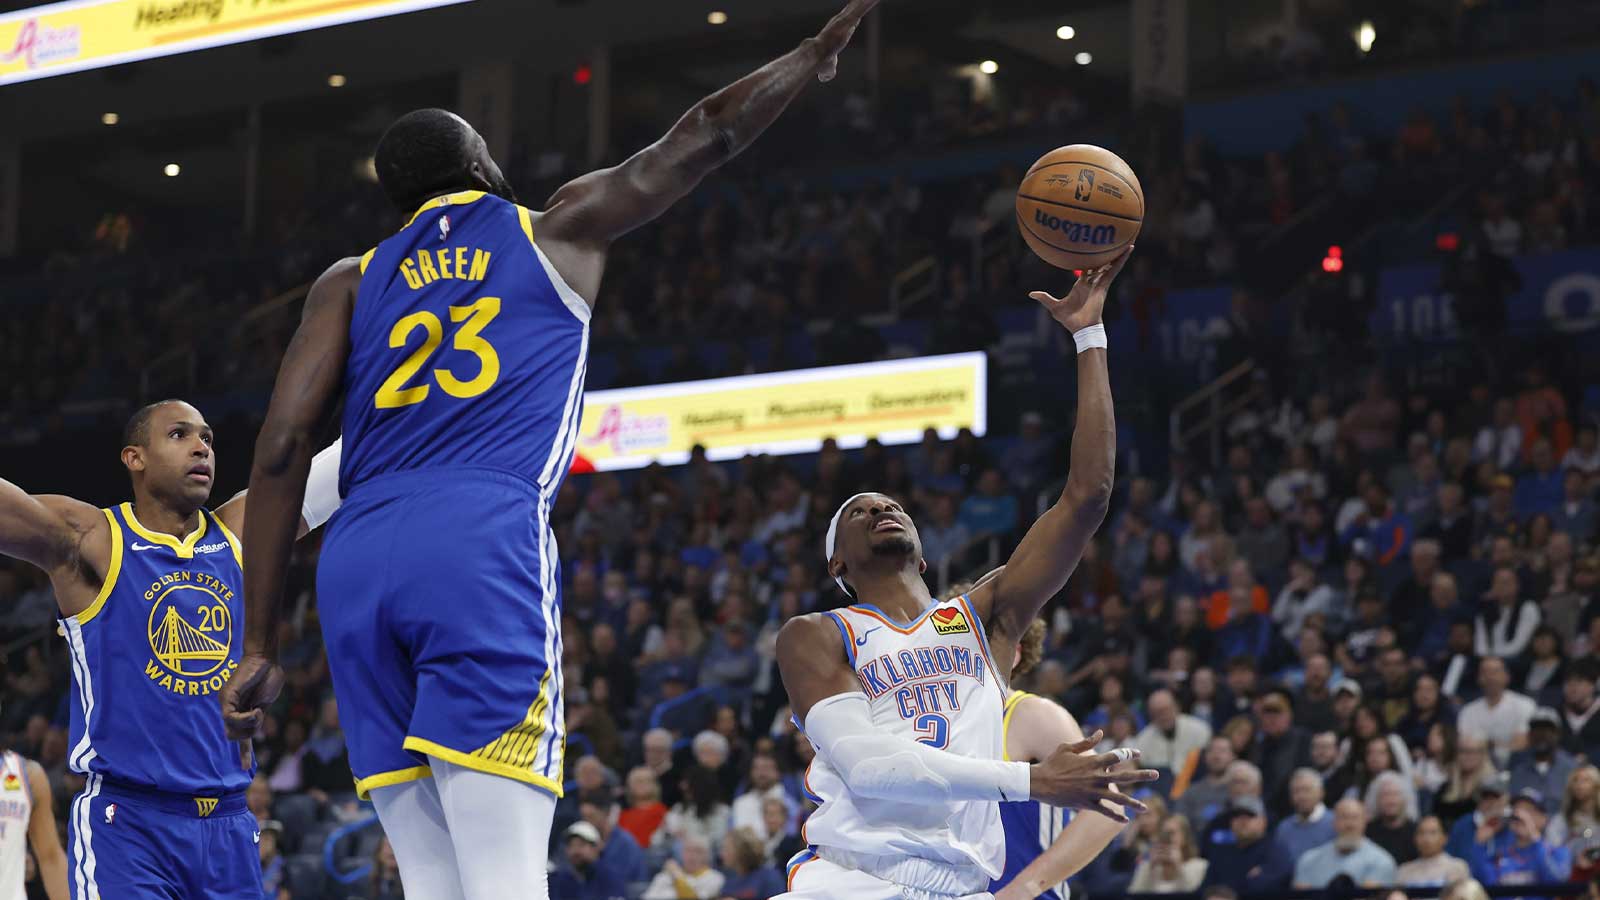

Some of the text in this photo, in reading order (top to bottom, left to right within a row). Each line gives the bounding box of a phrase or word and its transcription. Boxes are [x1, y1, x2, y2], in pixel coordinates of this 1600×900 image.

[1035, 208, 1116, 245] Wilson
[400, 247, 491, 290] GREEN
[375, 296, 501, 409] 23
[193, 541, 229, 554] Rakuten
[144, 571, 234, 601] GOLDEN STATE
[197, 605, 226, 632] 20
[144, 659, 239, 696] WARRIORS
[895, 680, 961, 720] CITY
[914, 712, 950, 751] 2
